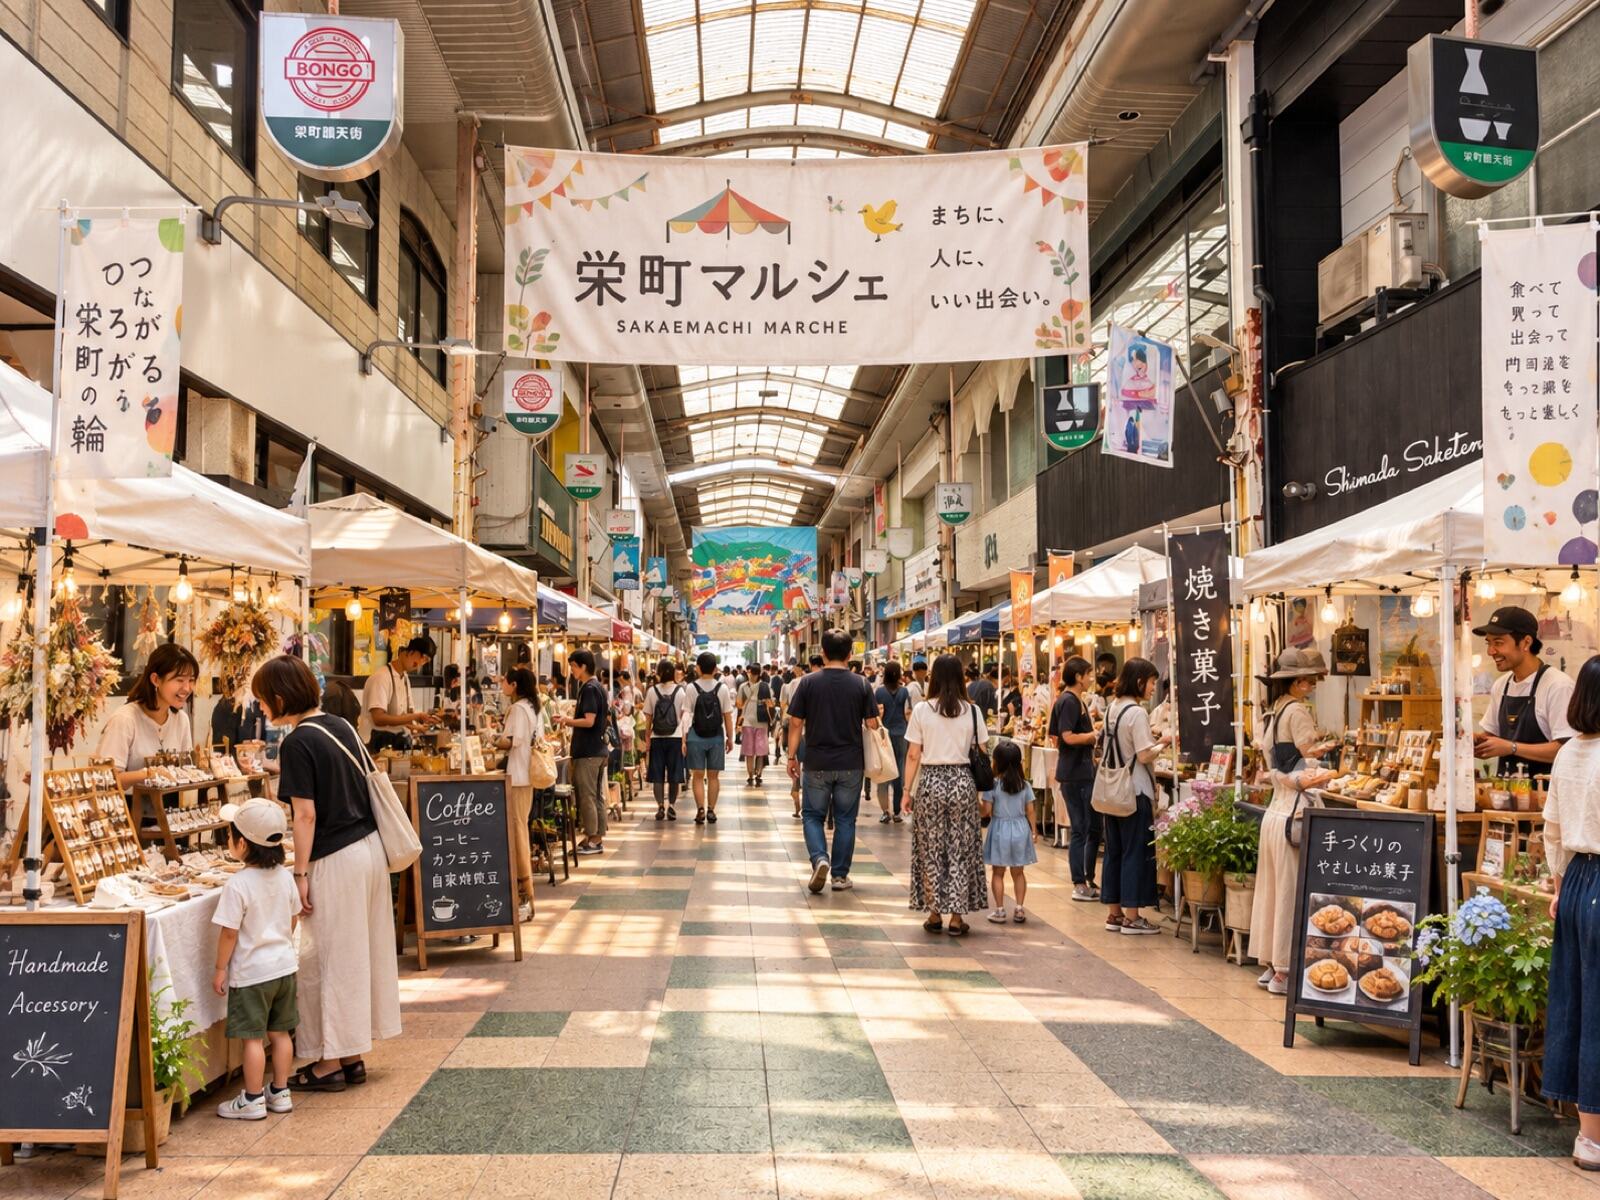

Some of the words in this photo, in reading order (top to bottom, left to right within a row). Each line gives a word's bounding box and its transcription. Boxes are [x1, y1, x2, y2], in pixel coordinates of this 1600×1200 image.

[297, 62, 363, 77] BONGO
[930, 205, 1005, 226] まちに、
[930, 248, 984, 269] 人に、
[573, 249, 889, 307] 栄町マルシェ
[929, 286, 1052, 311] いい出会い。
[129, 256, 163, 384] つながる
[616, 319, 753, 334] SAKAEMACHI
[763, 319, 849, 334] MARCHE
[1510, 328, 1568, 346] 出会って
[70, 302, 108, 455] 栄町の輪
[1324, 454, 1400, 497] Shimada
[1184, 565, 1221, 726] 焼き菓子
[426, 791, 497, 821] Coffee
[432, 833, 480, 847] コーヒー
[1321, 829, 1402, 854] 手づくりの
[432, 850, 493, 867] カフェラテ
[8, 948, 110, 977] Handmade
